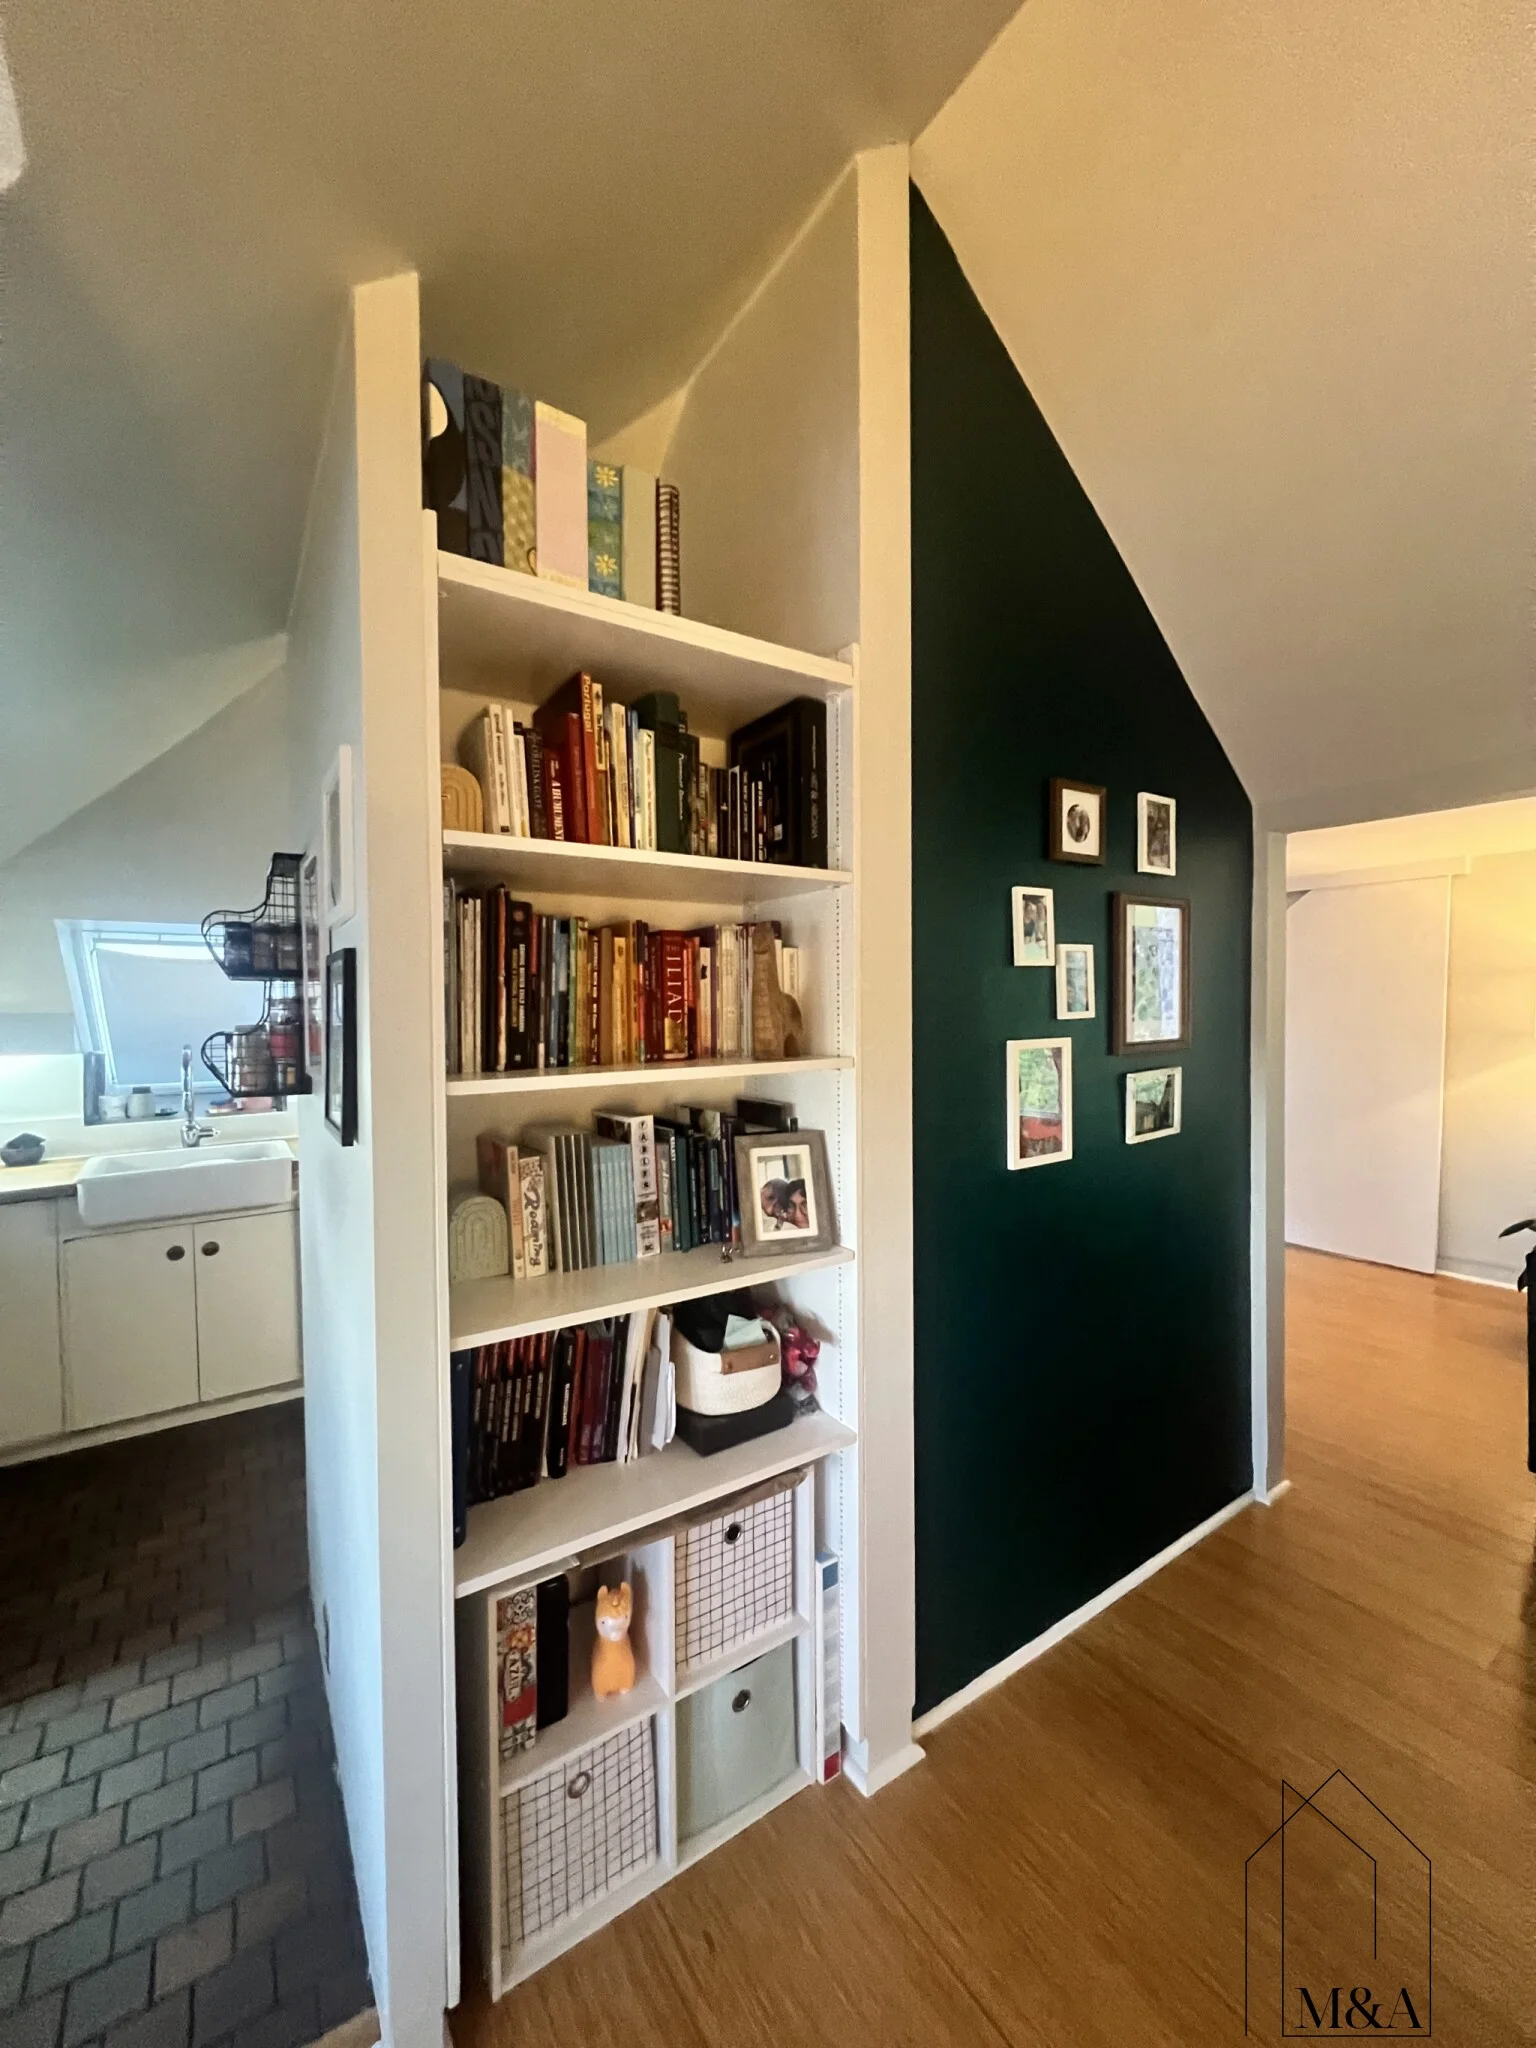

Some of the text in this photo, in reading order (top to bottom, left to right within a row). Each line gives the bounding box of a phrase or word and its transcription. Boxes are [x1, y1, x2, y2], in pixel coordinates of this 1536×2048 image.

[583, 674, 593, 733] Portugal
[666, 955, 684, 1024] ILIAD
[524, 1186, 544, 1267] Roaming
[508, 1655, 522, 1696] AZUL
